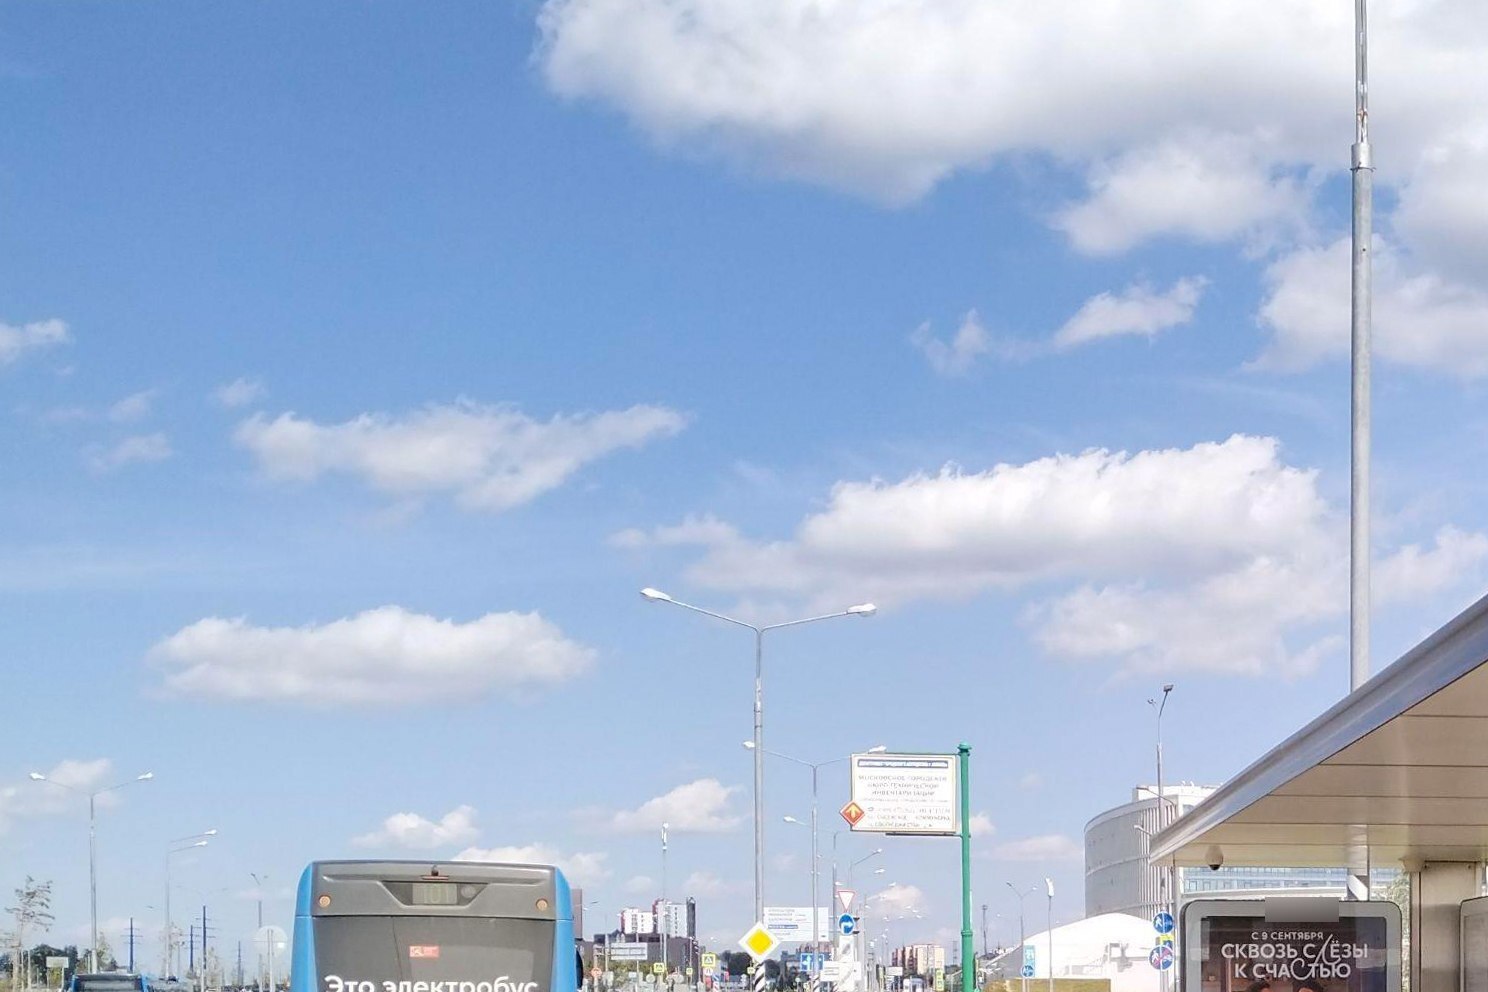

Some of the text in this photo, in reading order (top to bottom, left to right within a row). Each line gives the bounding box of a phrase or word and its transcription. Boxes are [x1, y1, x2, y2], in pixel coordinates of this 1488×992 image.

[1251, 931, 1324, 940] С 9 СЕНТЯБРЯ
[1221, 934, 1368, 966] СКВОЗЬ СЛЁЗЫ
[1235, 958, 1351, 980] К СЧАСТЬЮ
